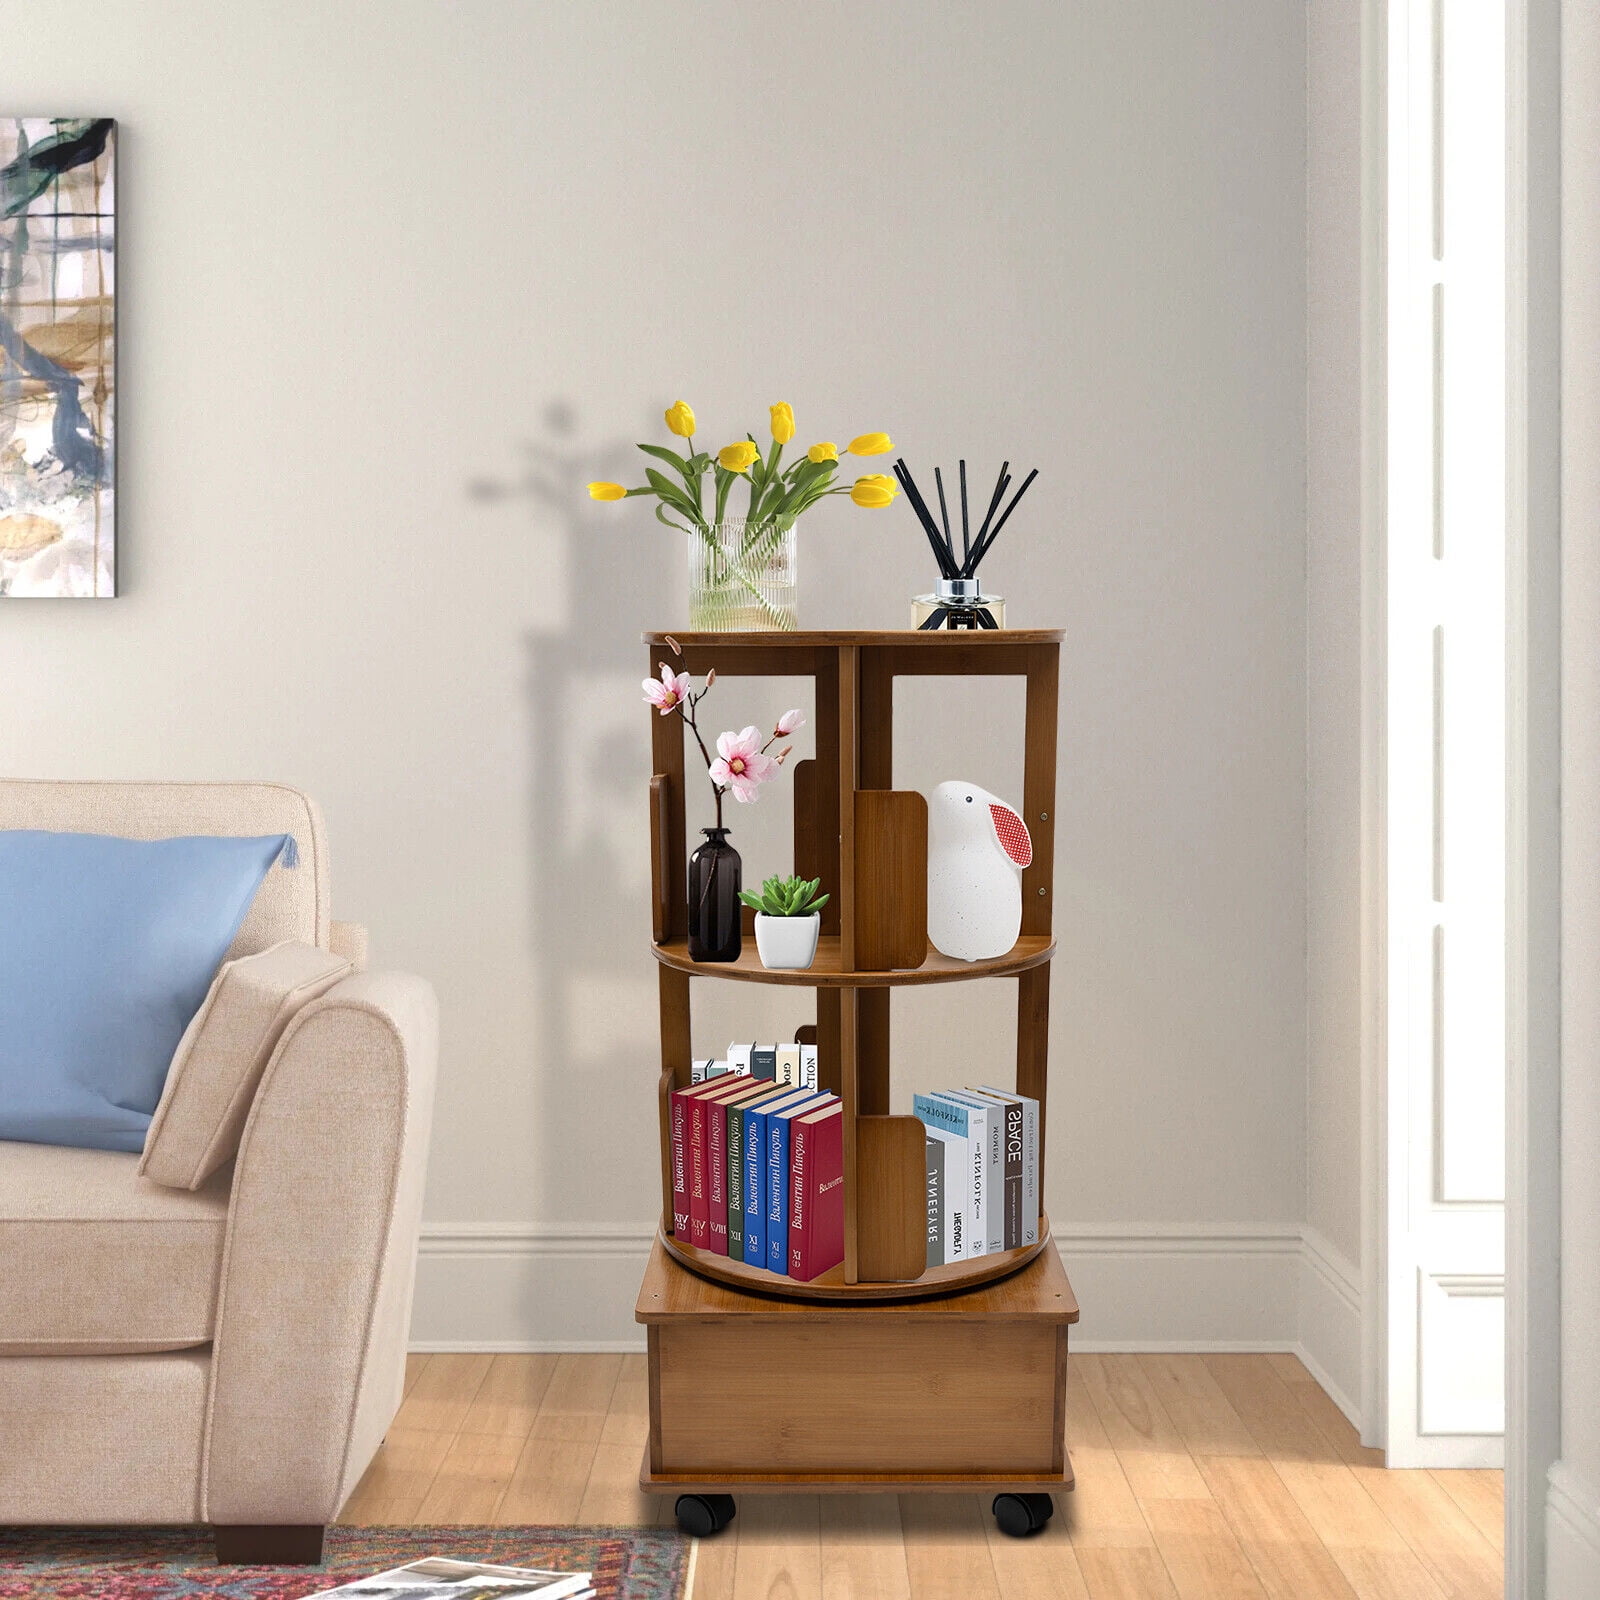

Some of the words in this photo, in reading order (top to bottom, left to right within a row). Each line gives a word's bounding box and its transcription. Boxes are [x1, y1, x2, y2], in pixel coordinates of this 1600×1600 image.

[807, 1058, 815, 1092] CTION
[673, 1104, 684, 1142] Пикуль
[691, 1108, 702, 1147] Пикуль
[711, 1112, 720, 1151] Пикуль
[729, 1117, 740, 1157] Пикуль
[746, 1122, 758, 1162] Пикуль
[769, 1127, 781, 1168] Пикуль
[792, 1133, 805, 1175] Пикуль
[674, 1144, 685, 1193] Валентин
[692, 1149, 702, 1199] Валентин
[711, 1152, 721, 1203] Валентин
[729, 1159, 740, 1210] Валентин
[747, 1164, 758, 1215] Валентин
[770, 1169, 781, 1222] Валентин
[792, 1176, 803, 1230] Валентин
[730, 1230, 741, 1241] XII
